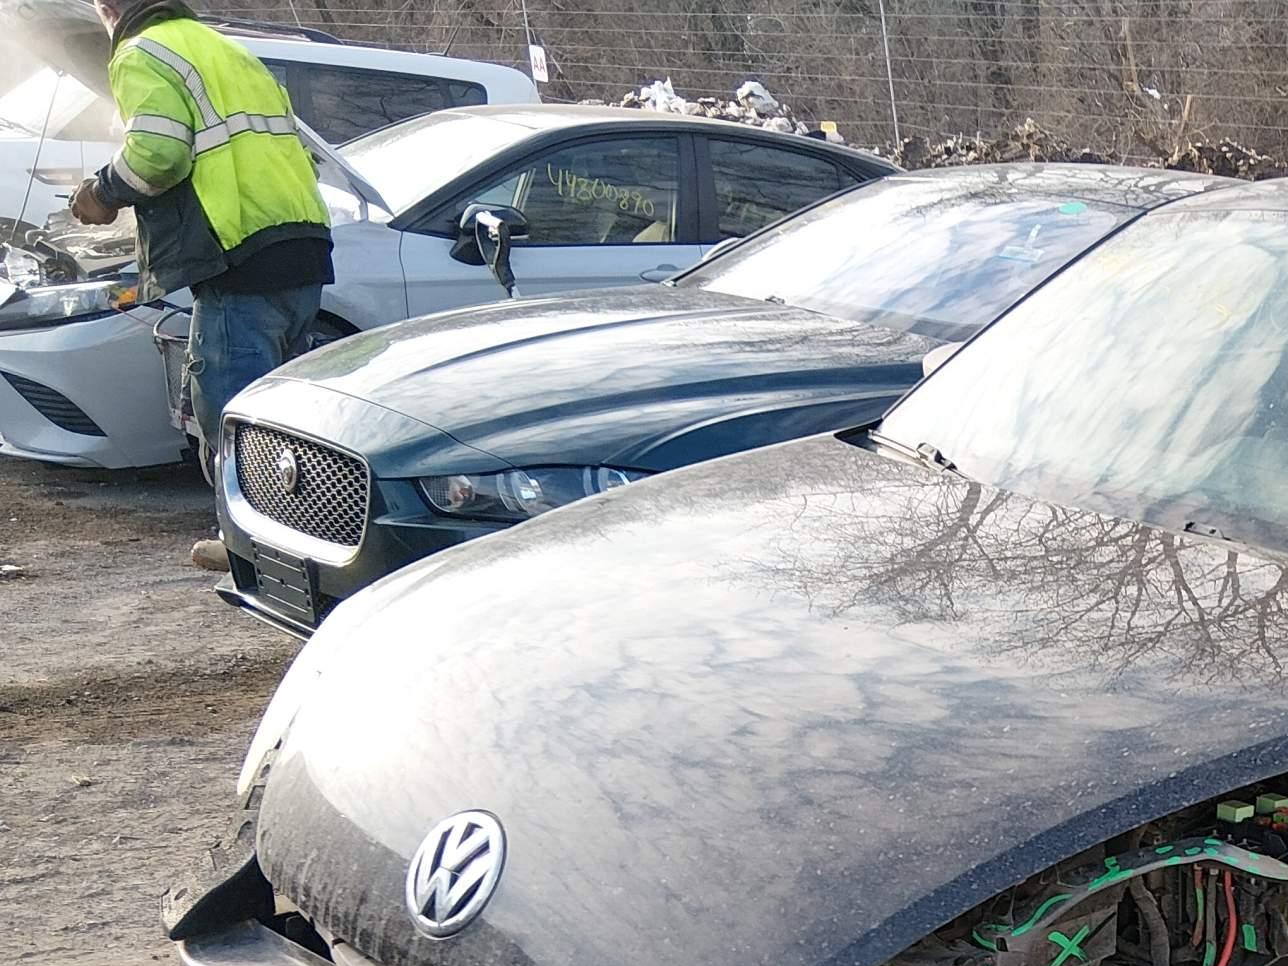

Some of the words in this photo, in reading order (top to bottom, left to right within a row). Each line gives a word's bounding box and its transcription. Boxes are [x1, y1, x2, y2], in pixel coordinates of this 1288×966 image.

[533, 55, 546, 73] AA
[546, 162, 655, 217] 44800890
[408, 811, 504, 936] VW
